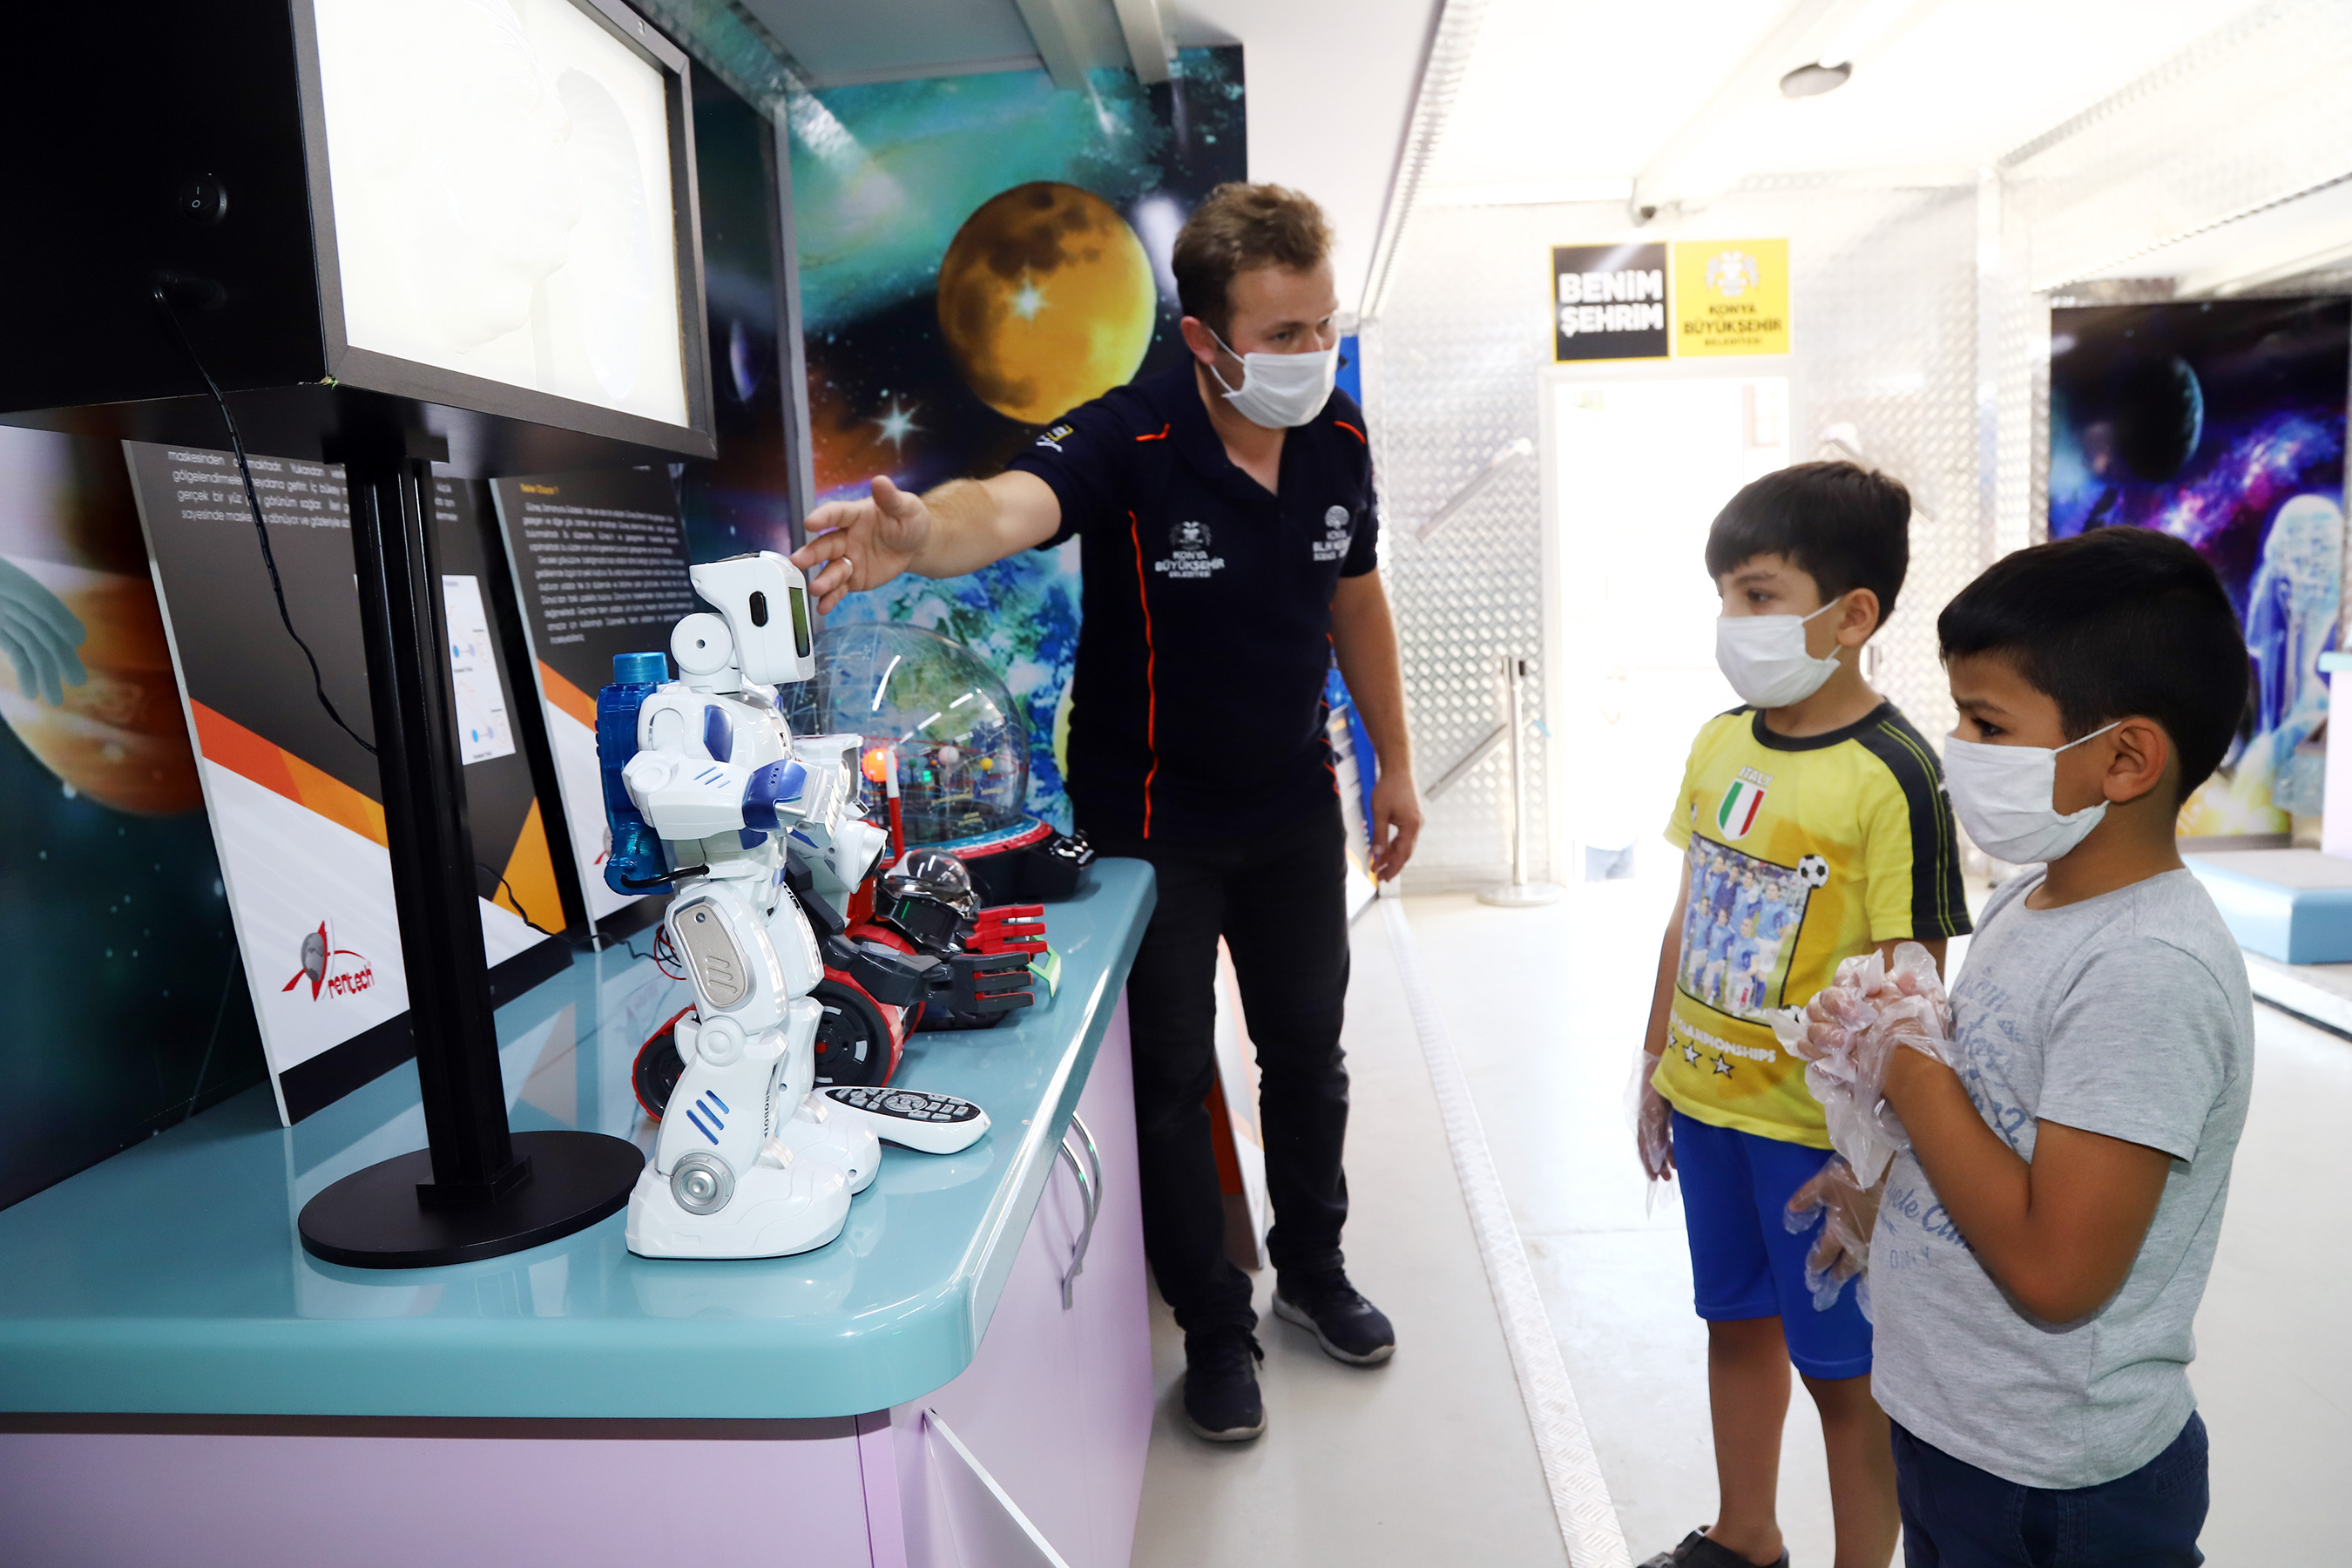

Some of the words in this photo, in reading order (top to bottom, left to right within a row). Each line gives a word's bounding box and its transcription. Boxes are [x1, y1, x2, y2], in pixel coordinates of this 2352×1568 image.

[1558, 269, 1664, 304] BENİM
[1559, 302, 1665, 338] ŞEHRİM
[1709, 303, 1758, 316] KONYA
[1683, 317, 1782, 335] BÜYÜKŞEHİR
[1738, 765, 1775, 787] ITALY
